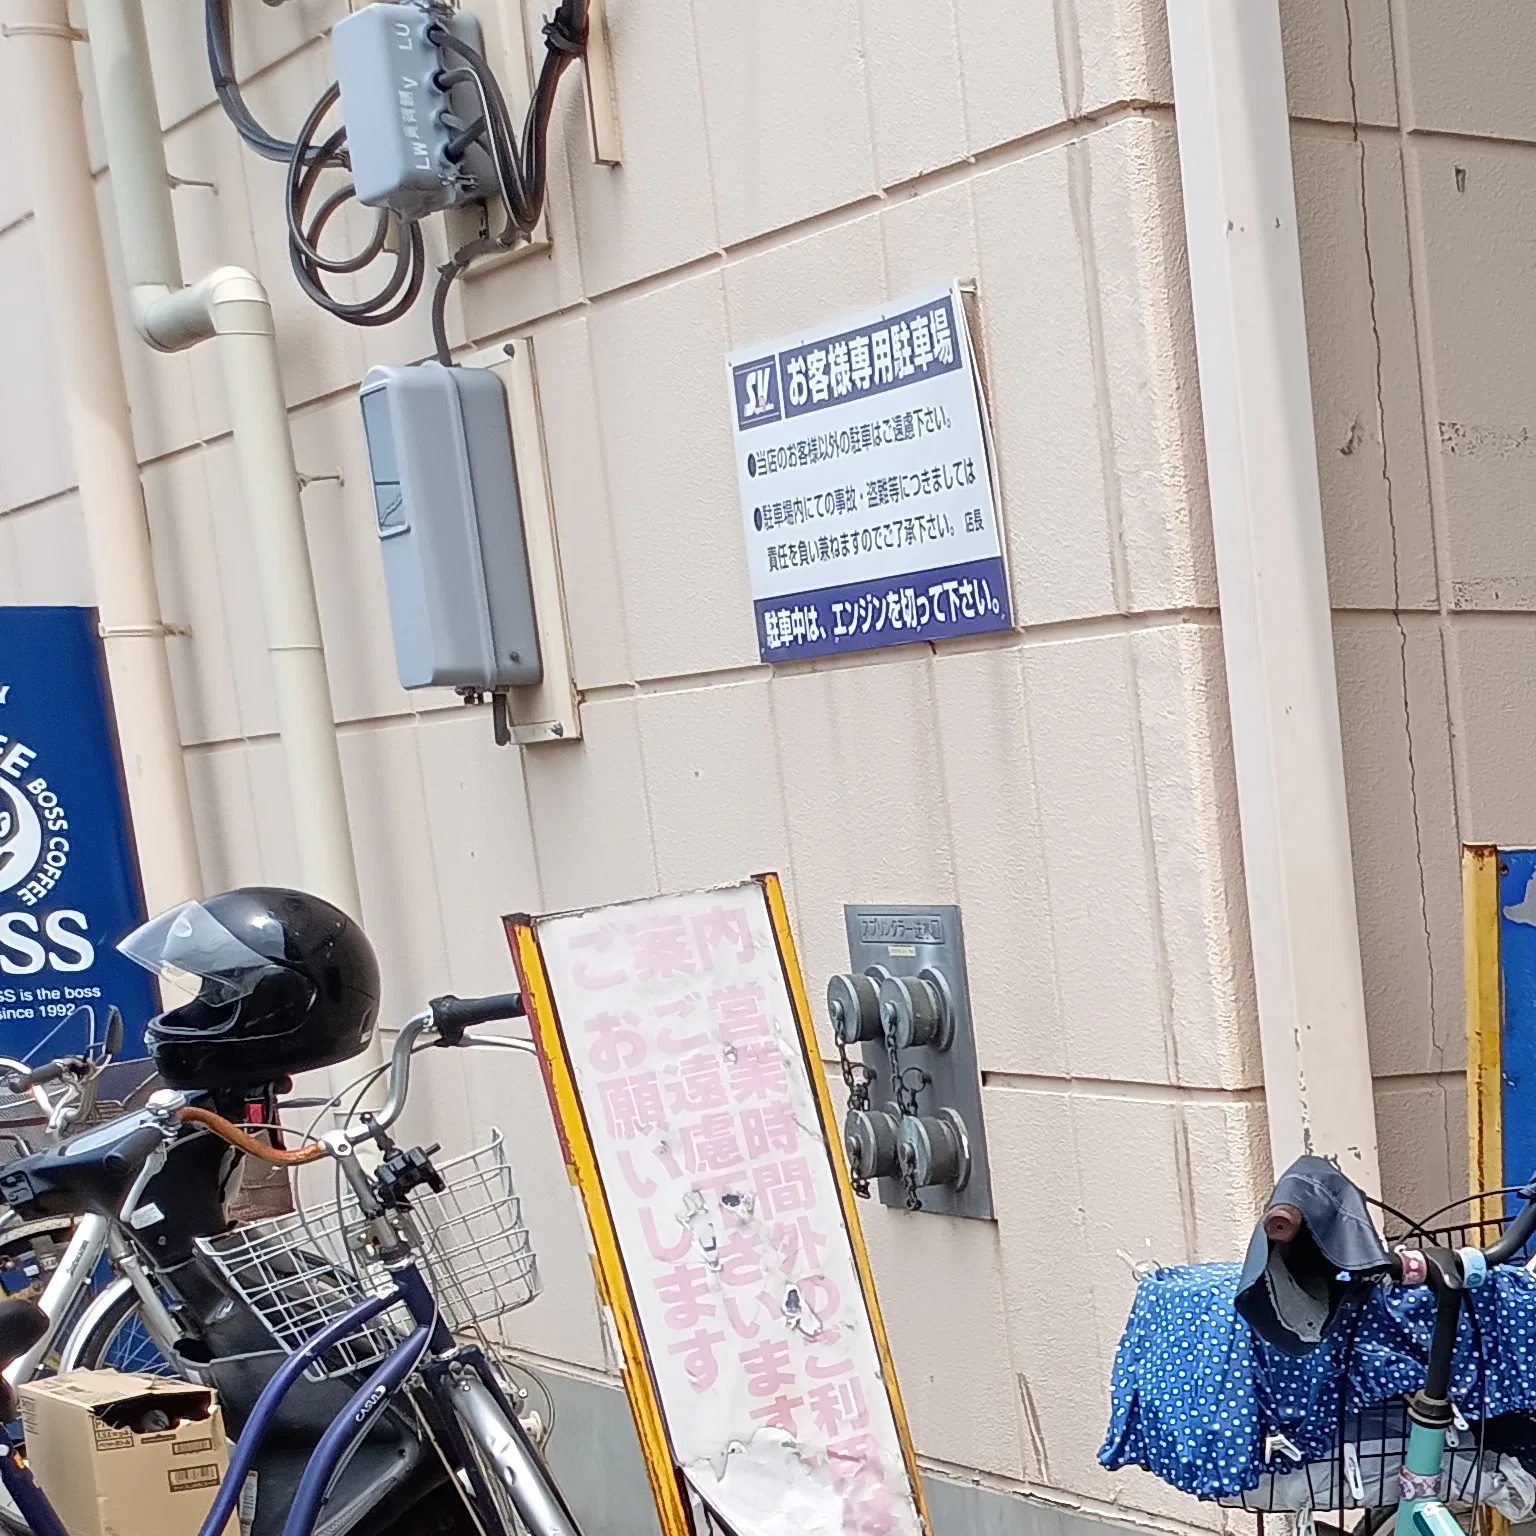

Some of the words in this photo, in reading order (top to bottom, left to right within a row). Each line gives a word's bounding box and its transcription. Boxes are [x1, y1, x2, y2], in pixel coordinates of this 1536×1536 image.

[786, 307, 954, 407] お客様専用駐車場
[964, 509, 985, 533] 店長
[764, 578, 1000, 649] 駐車中は、エンジンを切って下さい。
[26, 778, 69, 831] BOSS
[16, 837, 70, 907] COFFEE
[569, 904, 754, 990] ご案内
[19, 989, 34, 1002] is
[36, 987, 61, 1001] the
[64, 985, 102, 999] boss
[39, 1002, 76, 1018] 1992
[583, 1007, 724, 1395] お願いします
